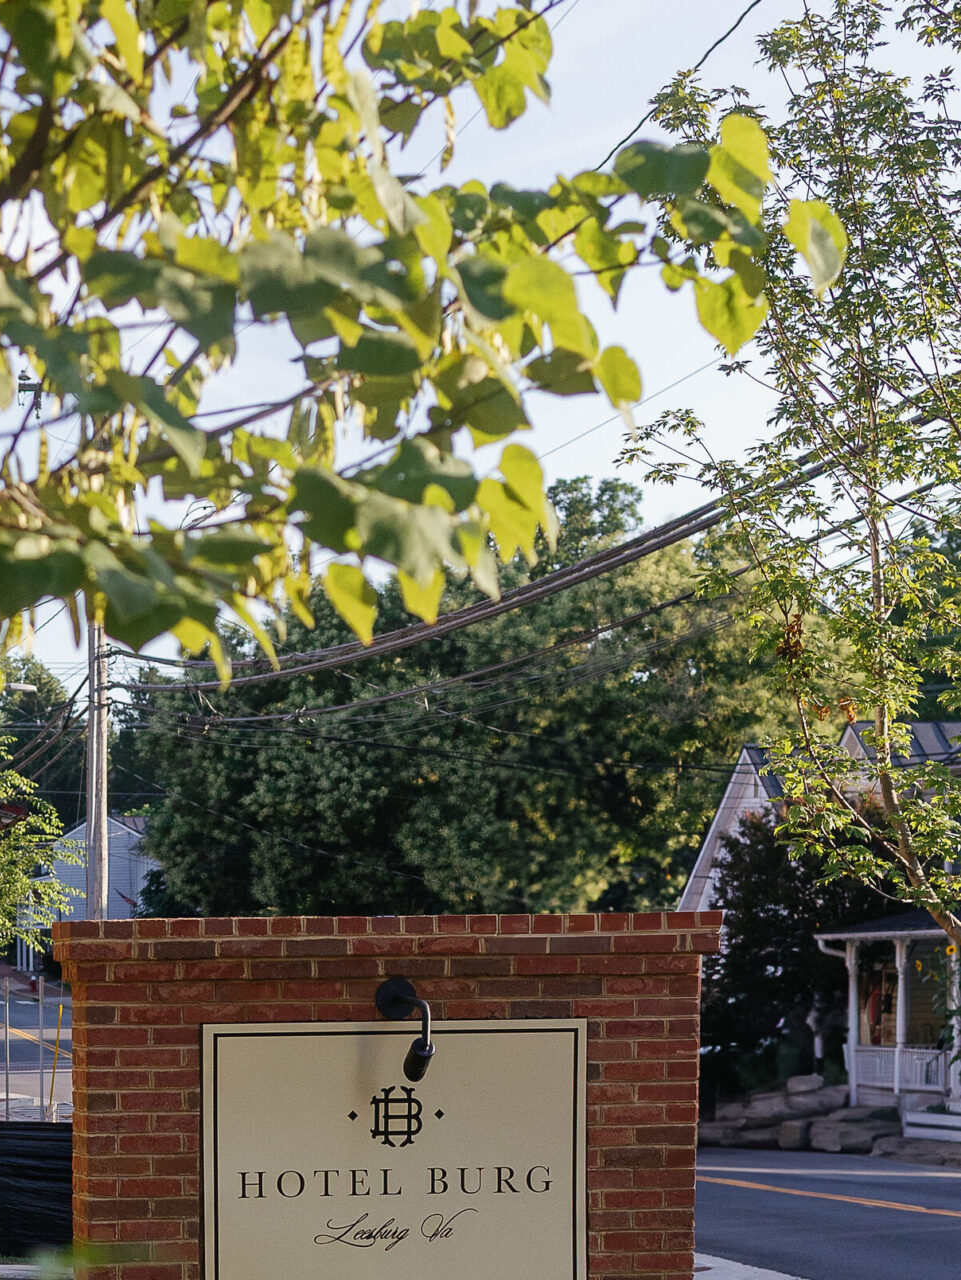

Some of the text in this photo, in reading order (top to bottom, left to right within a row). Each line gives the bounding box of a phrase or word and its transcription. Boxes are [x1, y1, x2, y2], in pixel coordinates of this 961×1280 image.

[237, 1165, 553, 1200] HOTEL BURG
[313, 1207, 479, 1252] Leesburg Va
